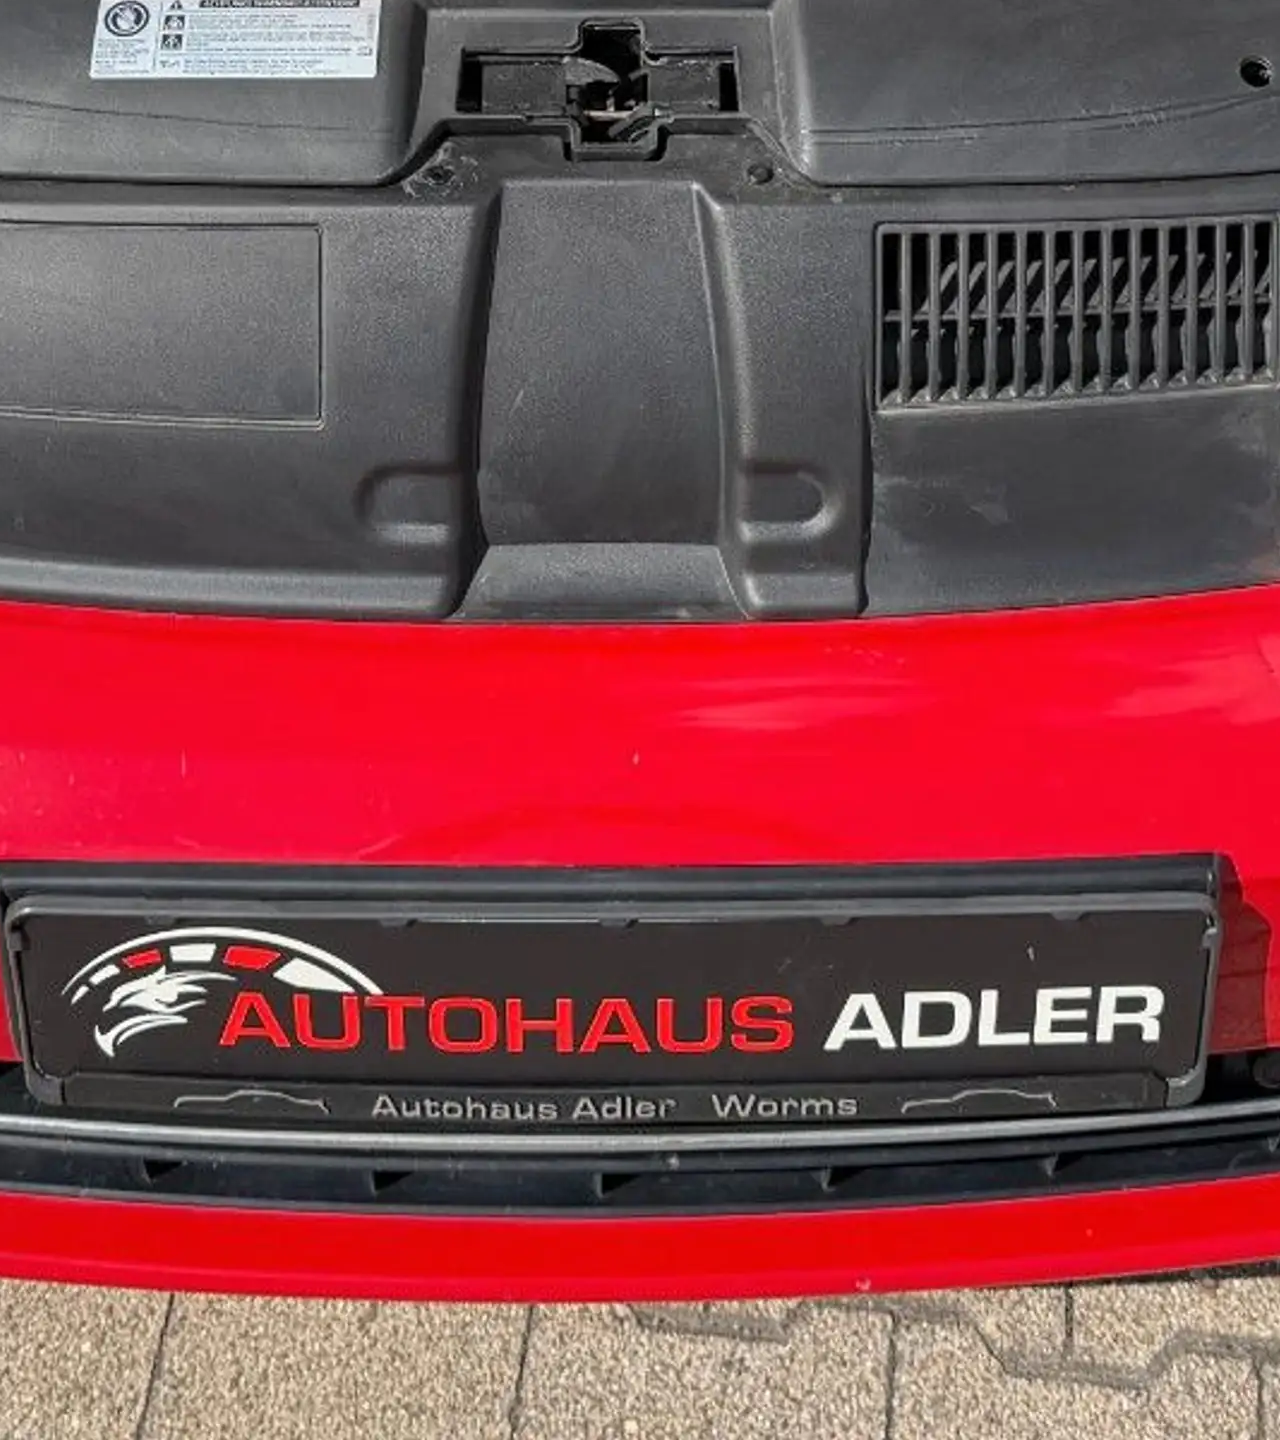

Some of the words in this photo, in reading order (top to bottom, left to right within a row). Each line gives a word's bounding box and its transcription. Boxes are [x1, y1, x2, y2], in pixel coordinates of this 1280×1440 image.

[219, 991, 796, 1054] AUTOHAUS
[823, 985, 1165, 1051] ADLER
[371, 1093, 559, 1122] Autohaus
[572, 1095, 677, 1120] Adler
[711, 1093, 859, 1119] Worms
